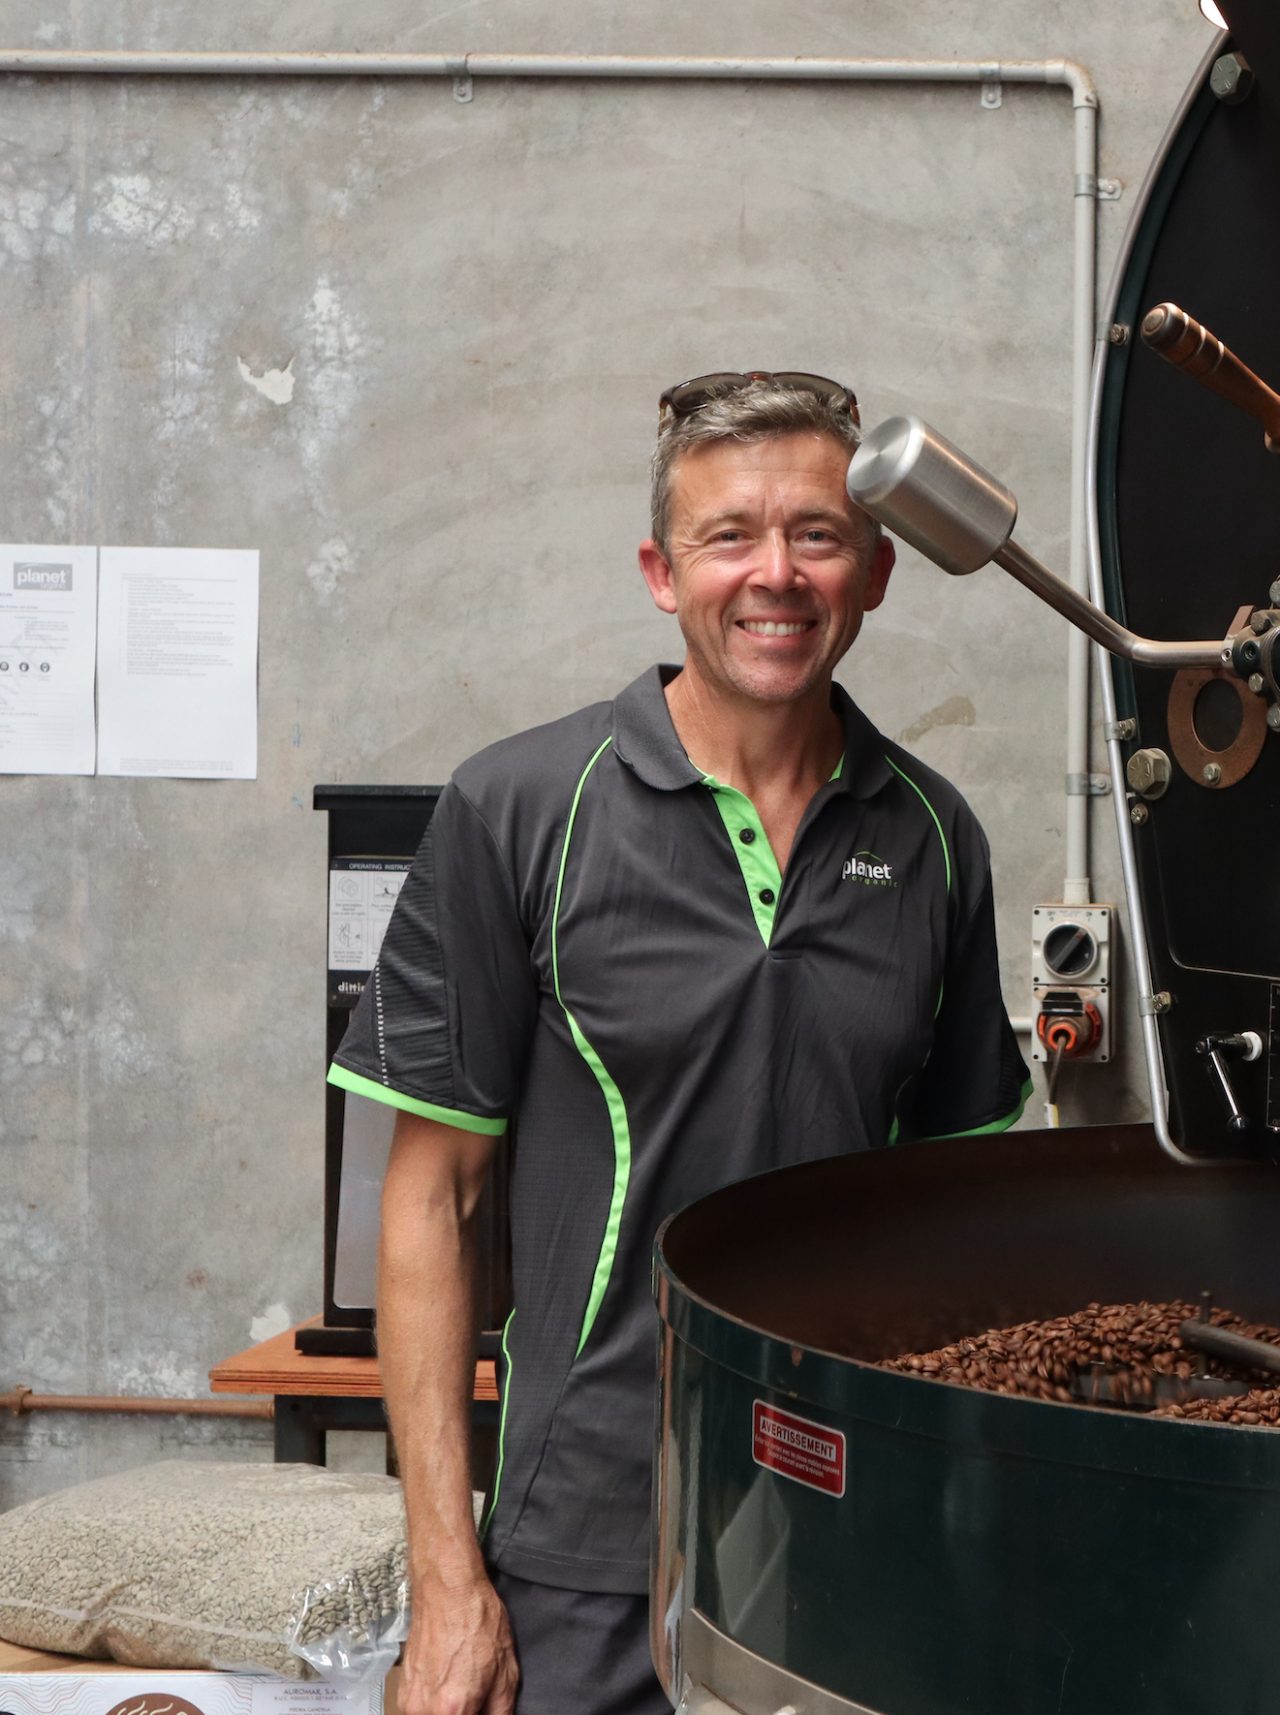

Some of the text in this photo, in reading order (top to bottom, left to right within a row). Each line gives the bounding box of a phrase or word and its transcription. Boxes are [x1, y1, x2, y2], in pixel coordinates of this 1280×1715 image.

[17, 568, 66, 586] planet
[842, 858, 892, 880] planet
[762, 1418, 833, 1458] AVERTISSEMENT
